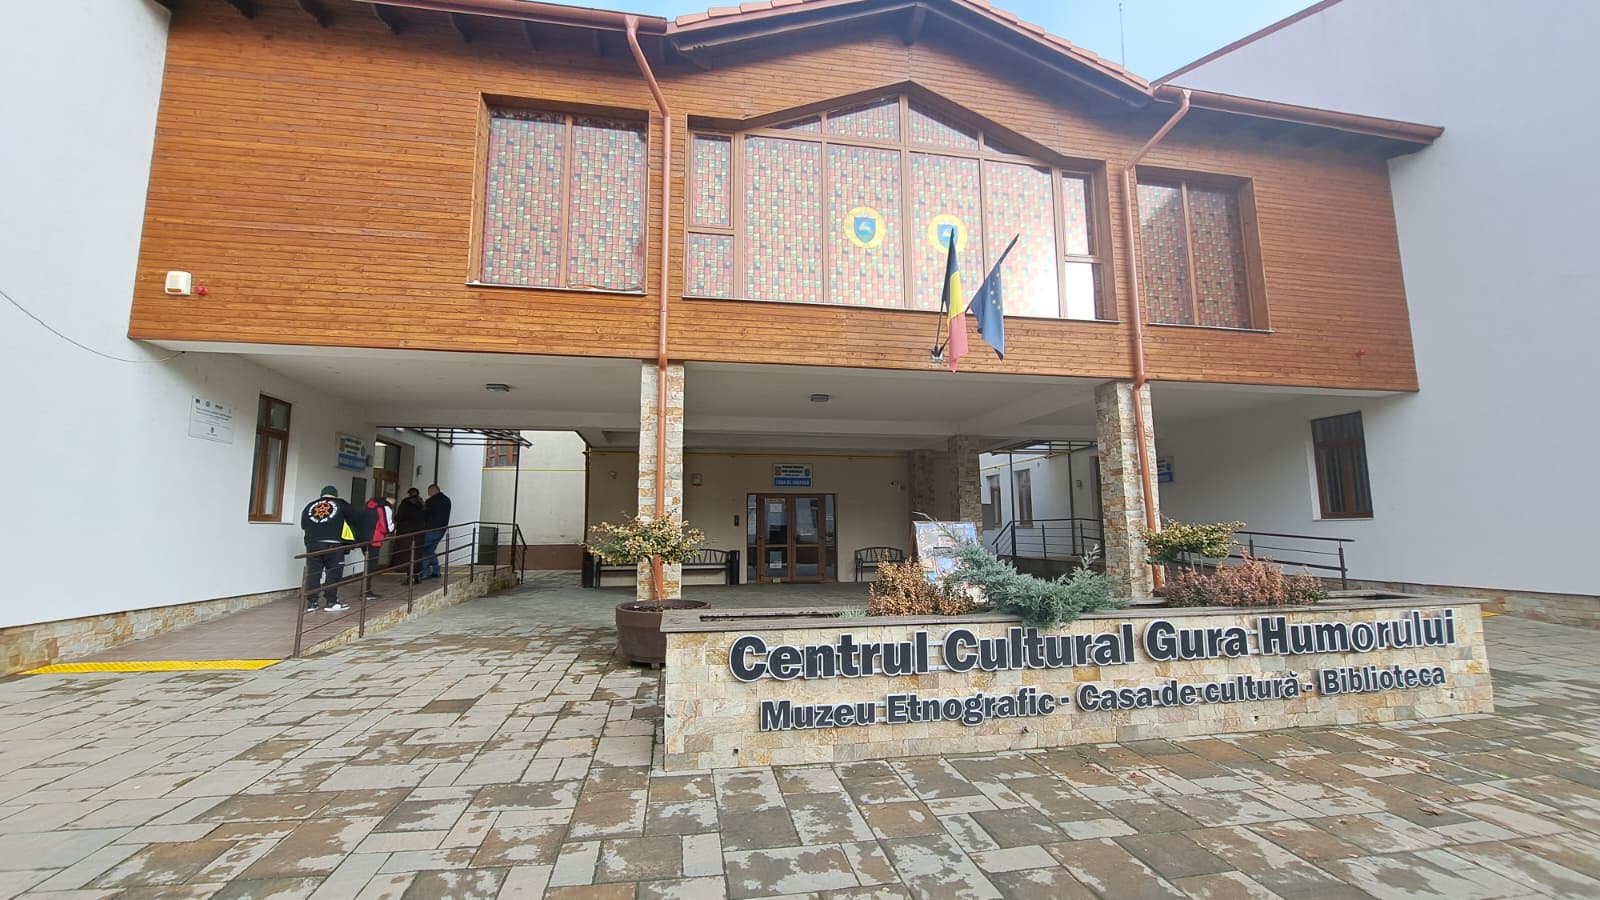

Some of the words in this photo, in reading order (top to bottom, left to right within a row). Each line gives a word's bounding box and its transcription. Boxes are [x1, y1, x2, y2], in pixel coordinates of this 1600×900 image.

[730, 631, 928, 681] Centrul
[943, 626, 1134, 672] Cultural
[1145, 620, 1248, 661] Gura
[1259, 610, 1455, 654] Humorului
[759, 699, 877, 732] Muzeu
[886, 687, 1056, 727] Etnografic
[1077, 683, 1153, 712] Casa
[1161, 680, 1197, 707] de
[1201, 671, 1299, 704] cultură
[1321, 666, 1445, 695] Biblioteca
